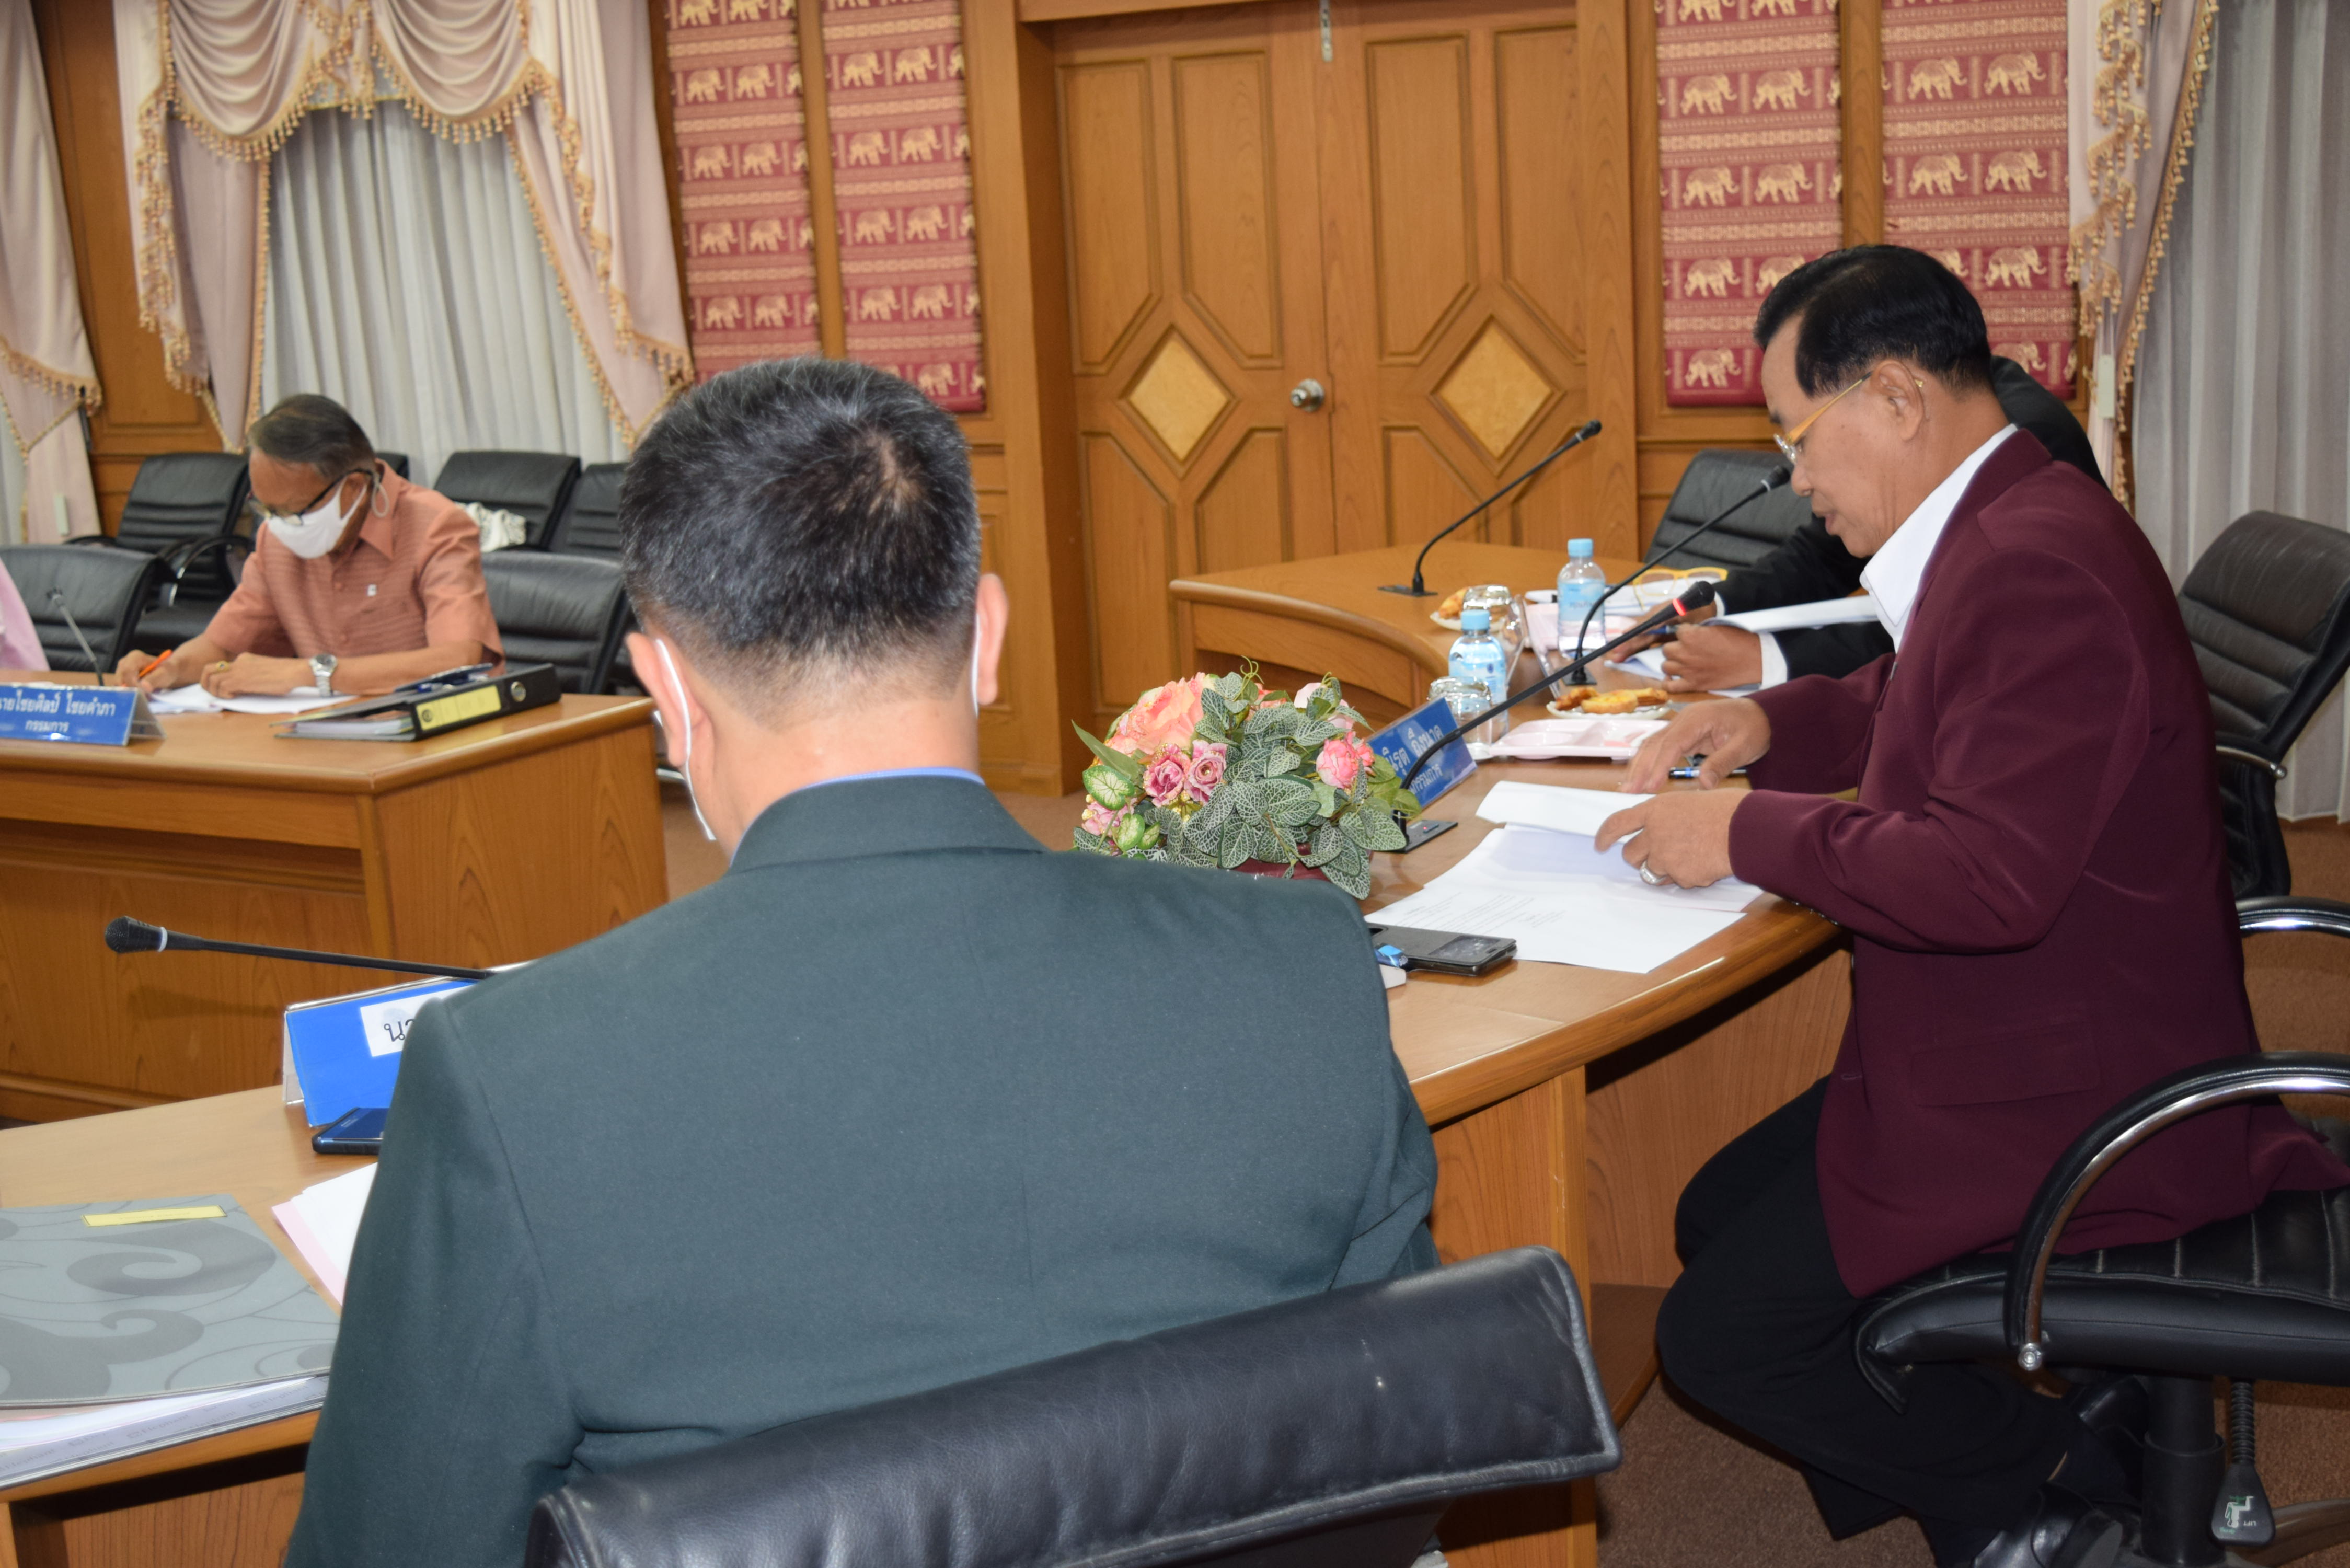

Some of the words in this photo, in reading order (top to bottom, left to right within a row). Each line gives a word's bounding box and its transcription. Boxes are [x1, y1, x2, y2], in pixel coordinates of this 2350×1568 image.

[0, 689, 61, 714] ายไชยศิลป์
[25, 720, 70, 733] กรรมการ
